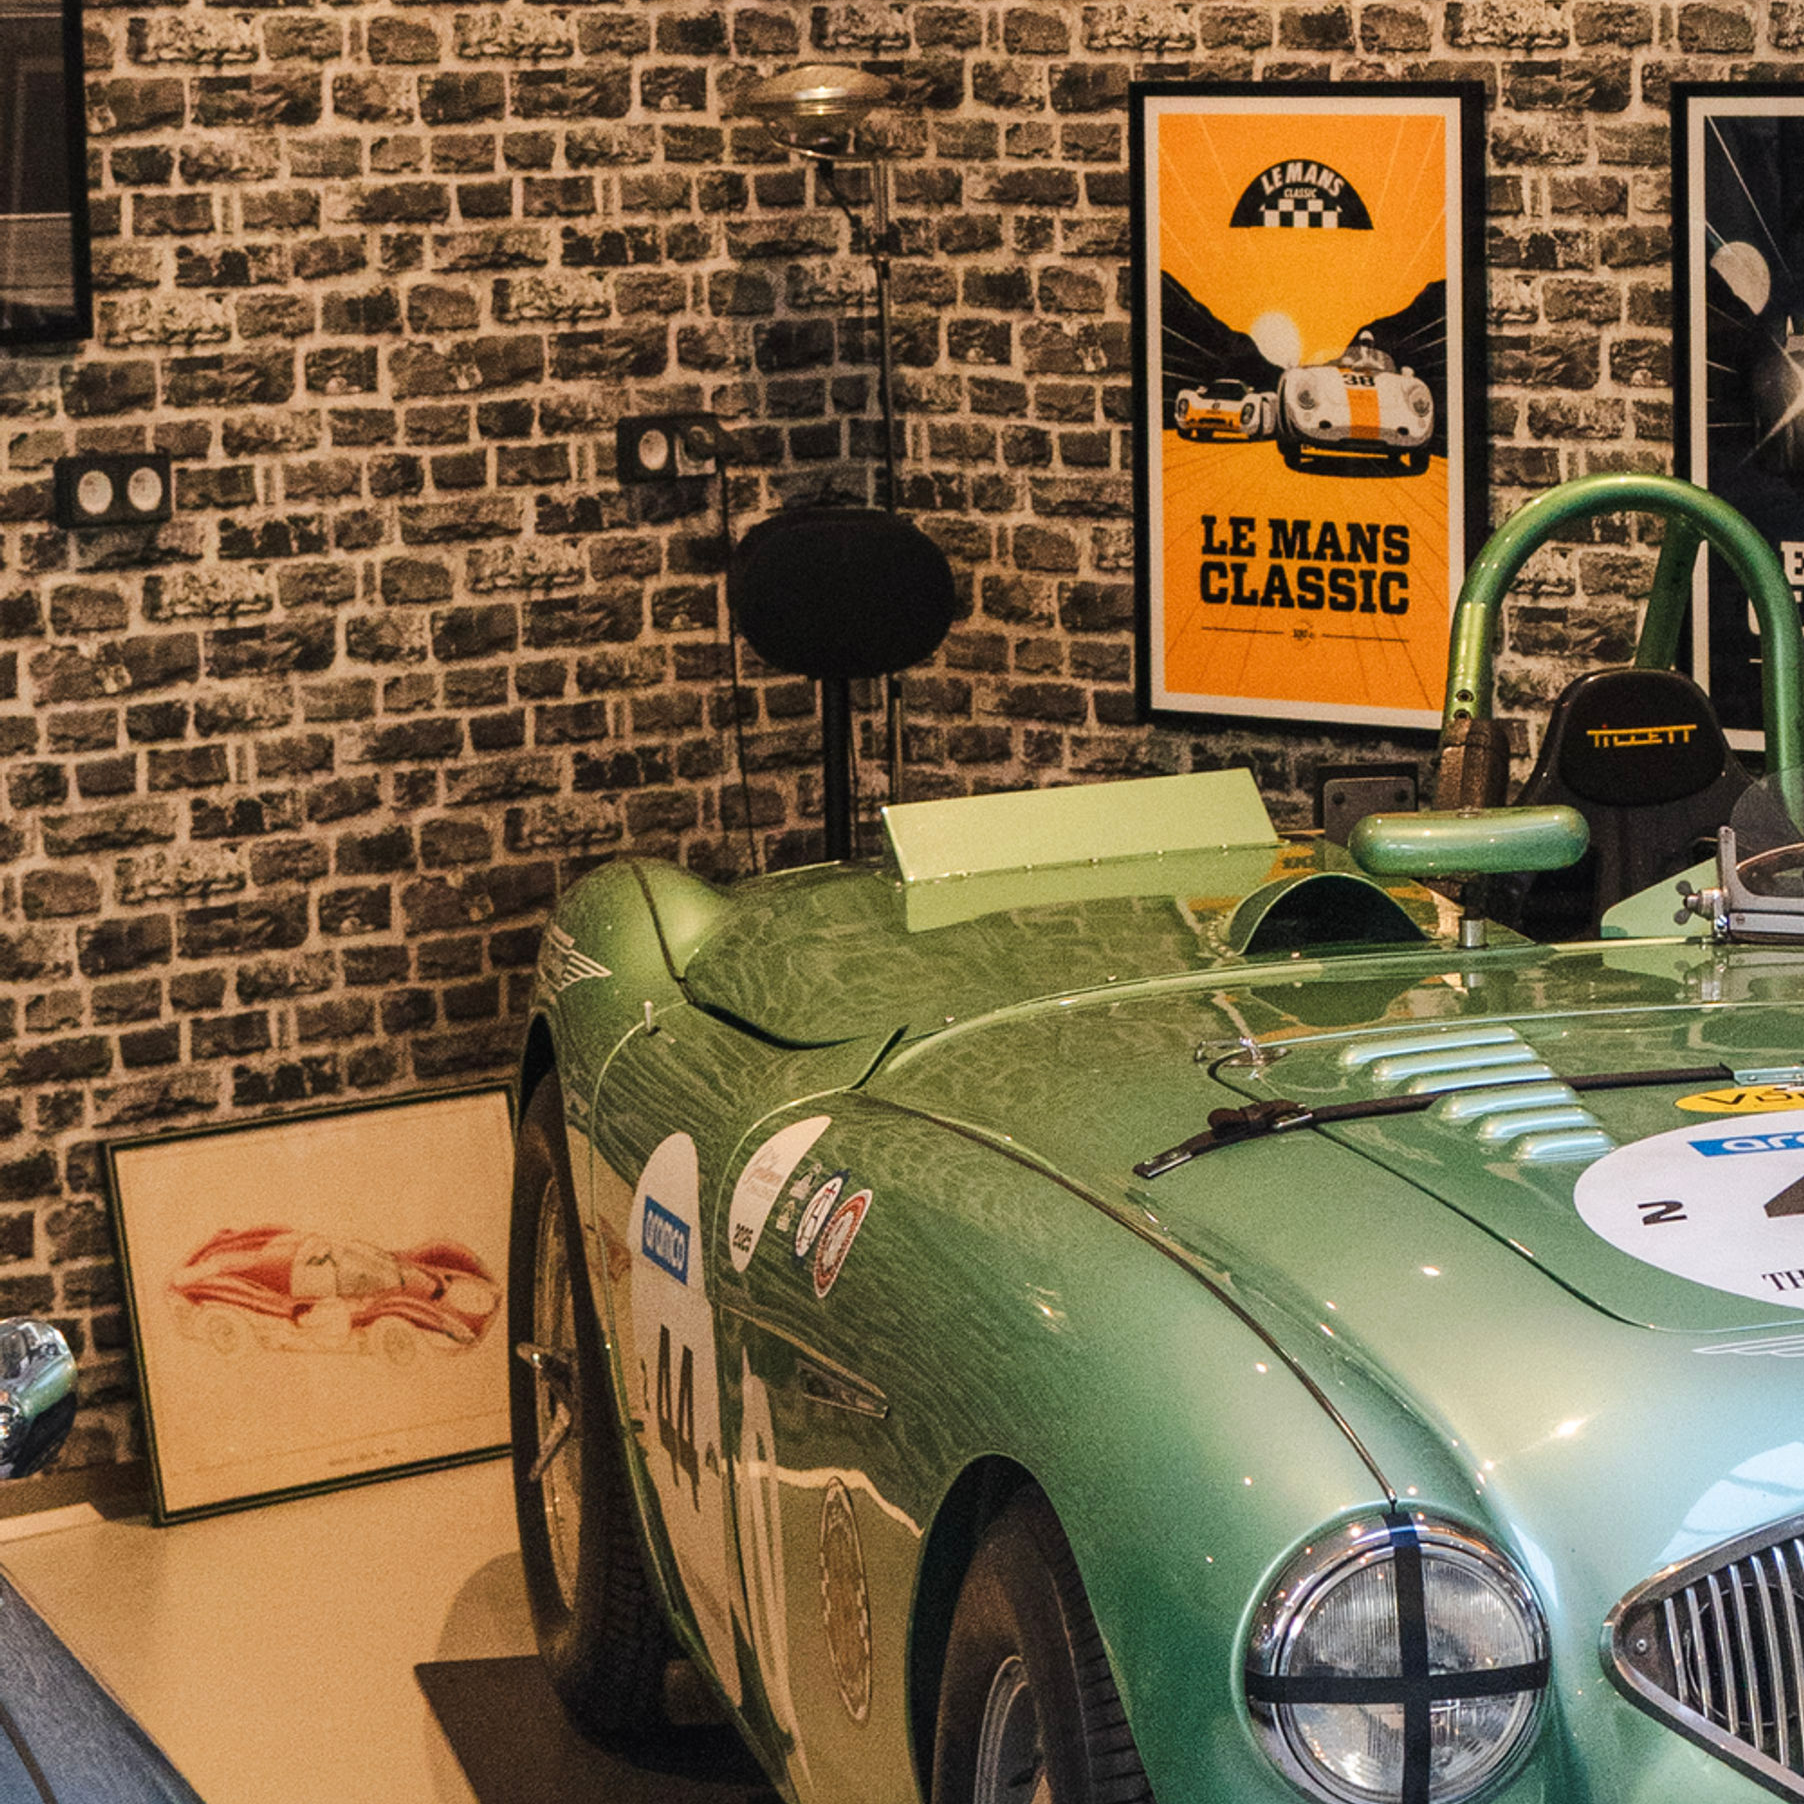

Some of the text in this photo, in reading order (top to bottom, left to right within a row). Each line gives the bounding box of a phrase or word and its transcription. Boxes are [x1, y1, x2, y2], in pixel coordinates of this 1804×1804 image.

[1260, 161, 1345, 197] LE MANS
[1201, 514, 1410, 566] LE MANS
[1200, 561, 1409, 616] CLASSIC
[657, 1323, 701, 1513] 44
